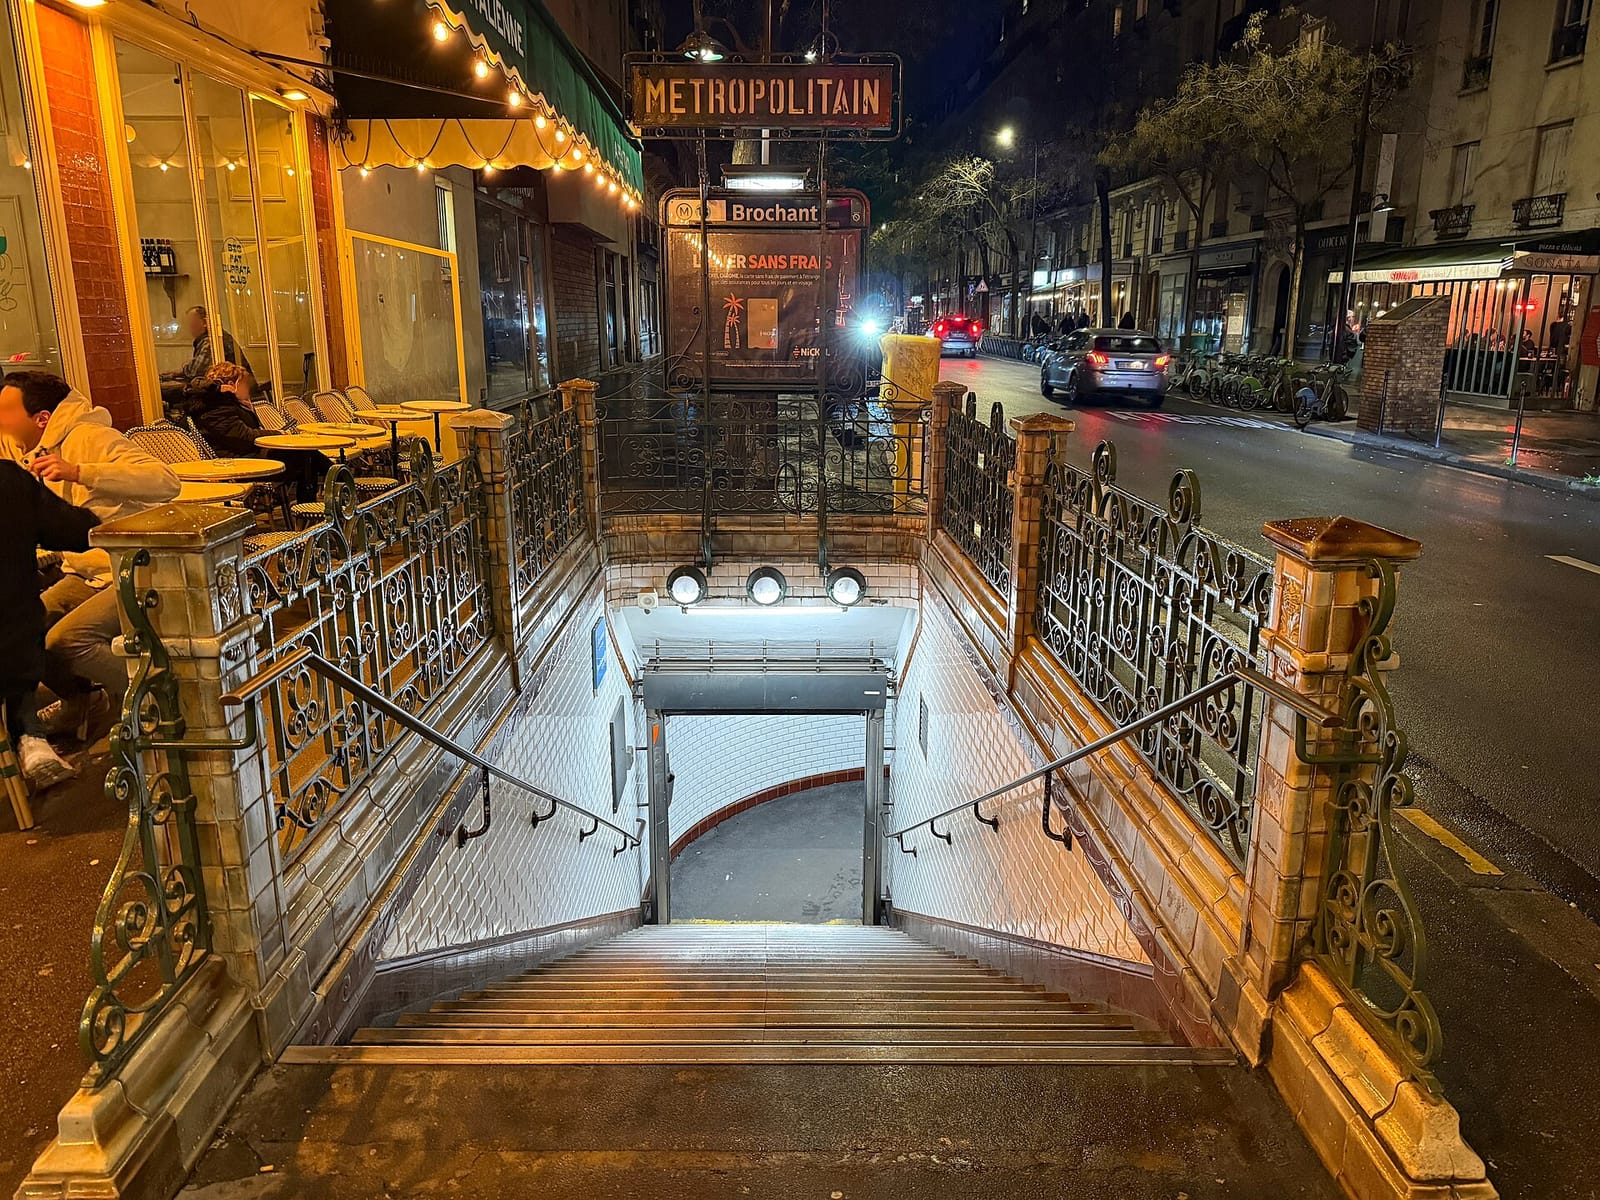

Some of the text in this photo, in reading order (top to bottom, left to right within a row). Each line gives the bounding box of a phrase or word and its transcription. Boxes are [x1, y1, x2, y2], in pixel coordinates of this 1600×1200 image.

[645, 78, 880, 115] METROPOLITAIN
[732, 203, 818, 222] Brochant
[749, 254, 787, 269] SANS
[1525, 255, 1581, 271] SONATA
[803, 273, 821, 281] l'étrange
[800, 347, 831, 357] NiCKL
